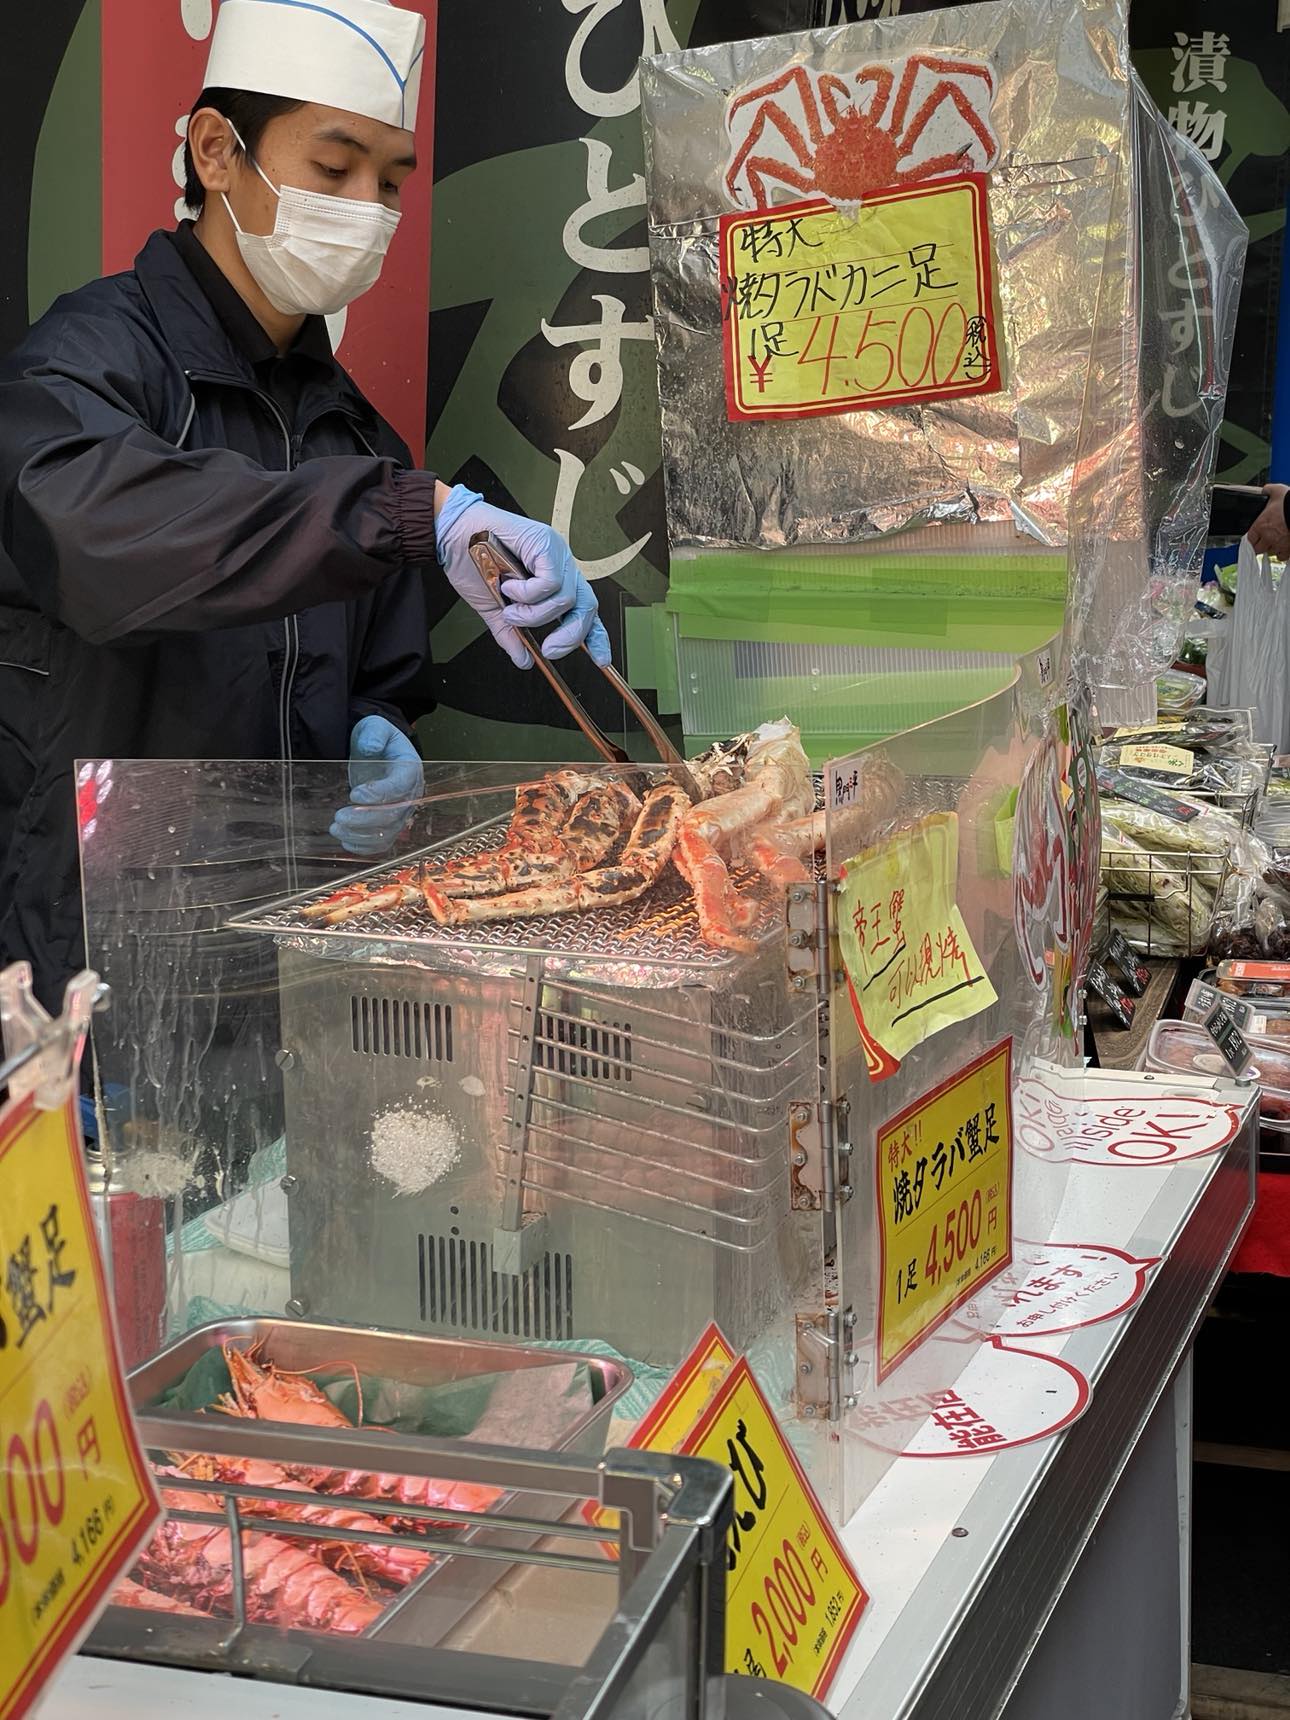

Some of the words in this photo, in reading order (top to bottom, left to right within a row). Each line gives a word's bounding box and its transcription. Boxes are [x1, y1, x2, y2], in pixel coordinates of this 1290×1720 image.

[741, 218, 825, 263] 特大
[893, 1102, 1000, 1225] 焼タラバ蟹足
[1107, 1111, 1217, 1160] OK!
[0, 1203, 77, 1349] 蟹足
